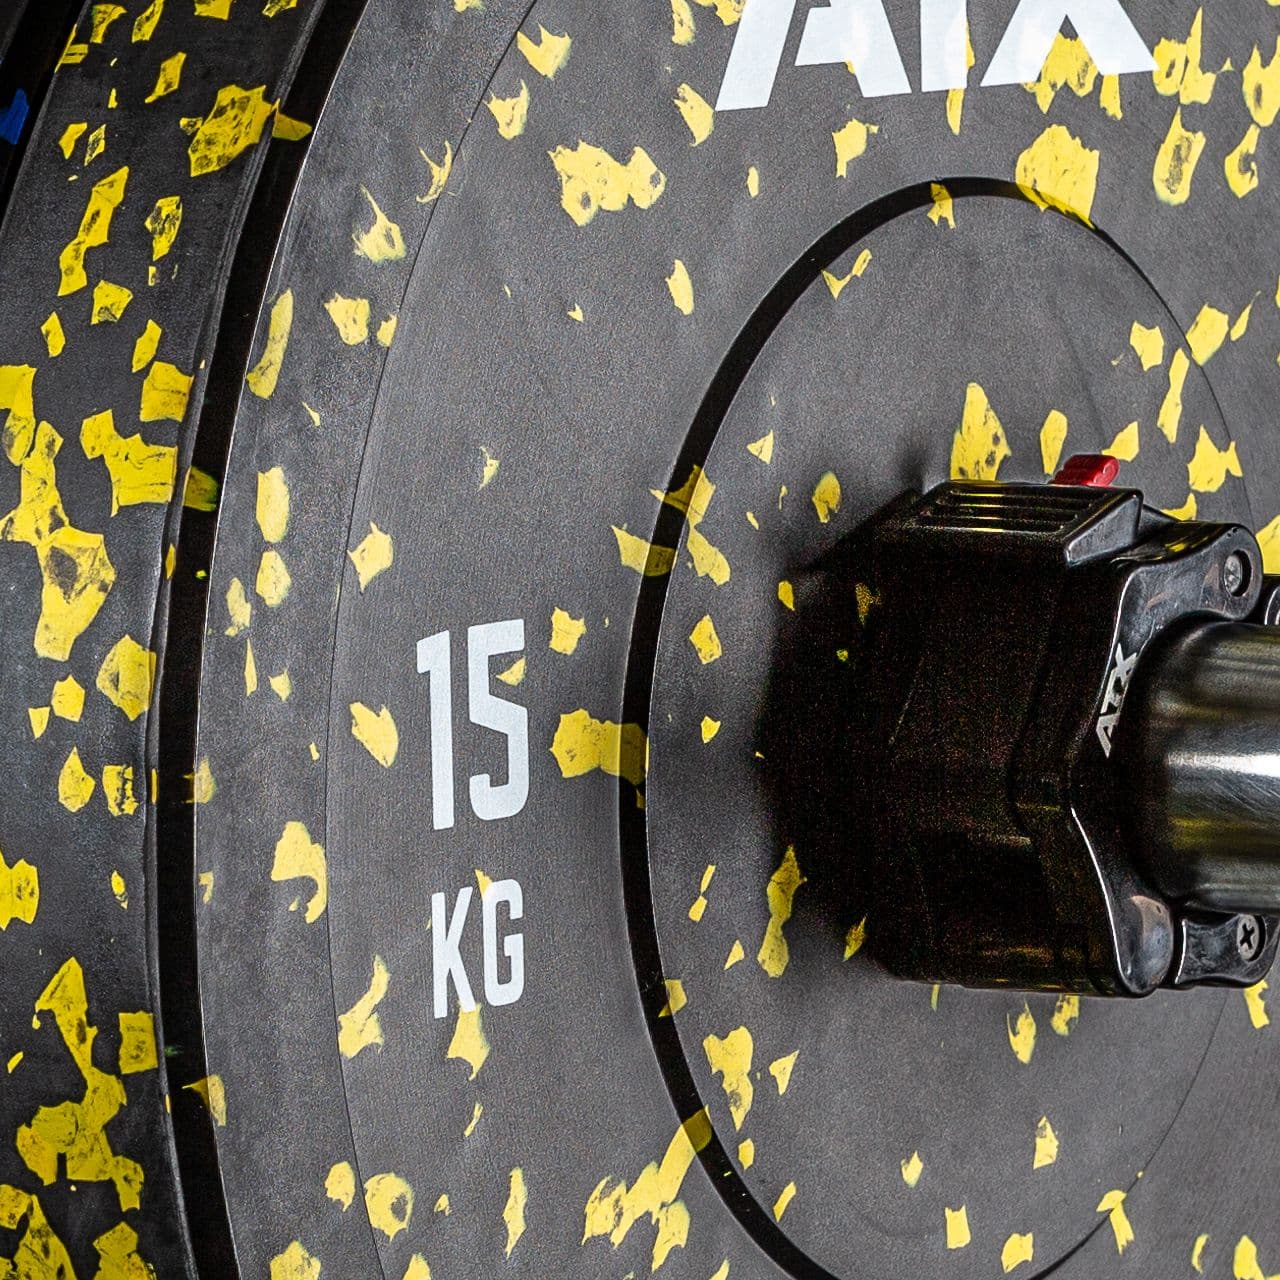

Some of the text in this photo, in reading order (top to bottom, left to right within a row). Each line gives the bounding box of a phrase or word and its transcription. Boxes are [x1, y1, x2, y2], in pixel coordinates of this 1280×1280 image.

[416, 618, 530, 831] 15
[1096, 642, 1138, 759] ATX
[431, 878, 524, 1019] KG
